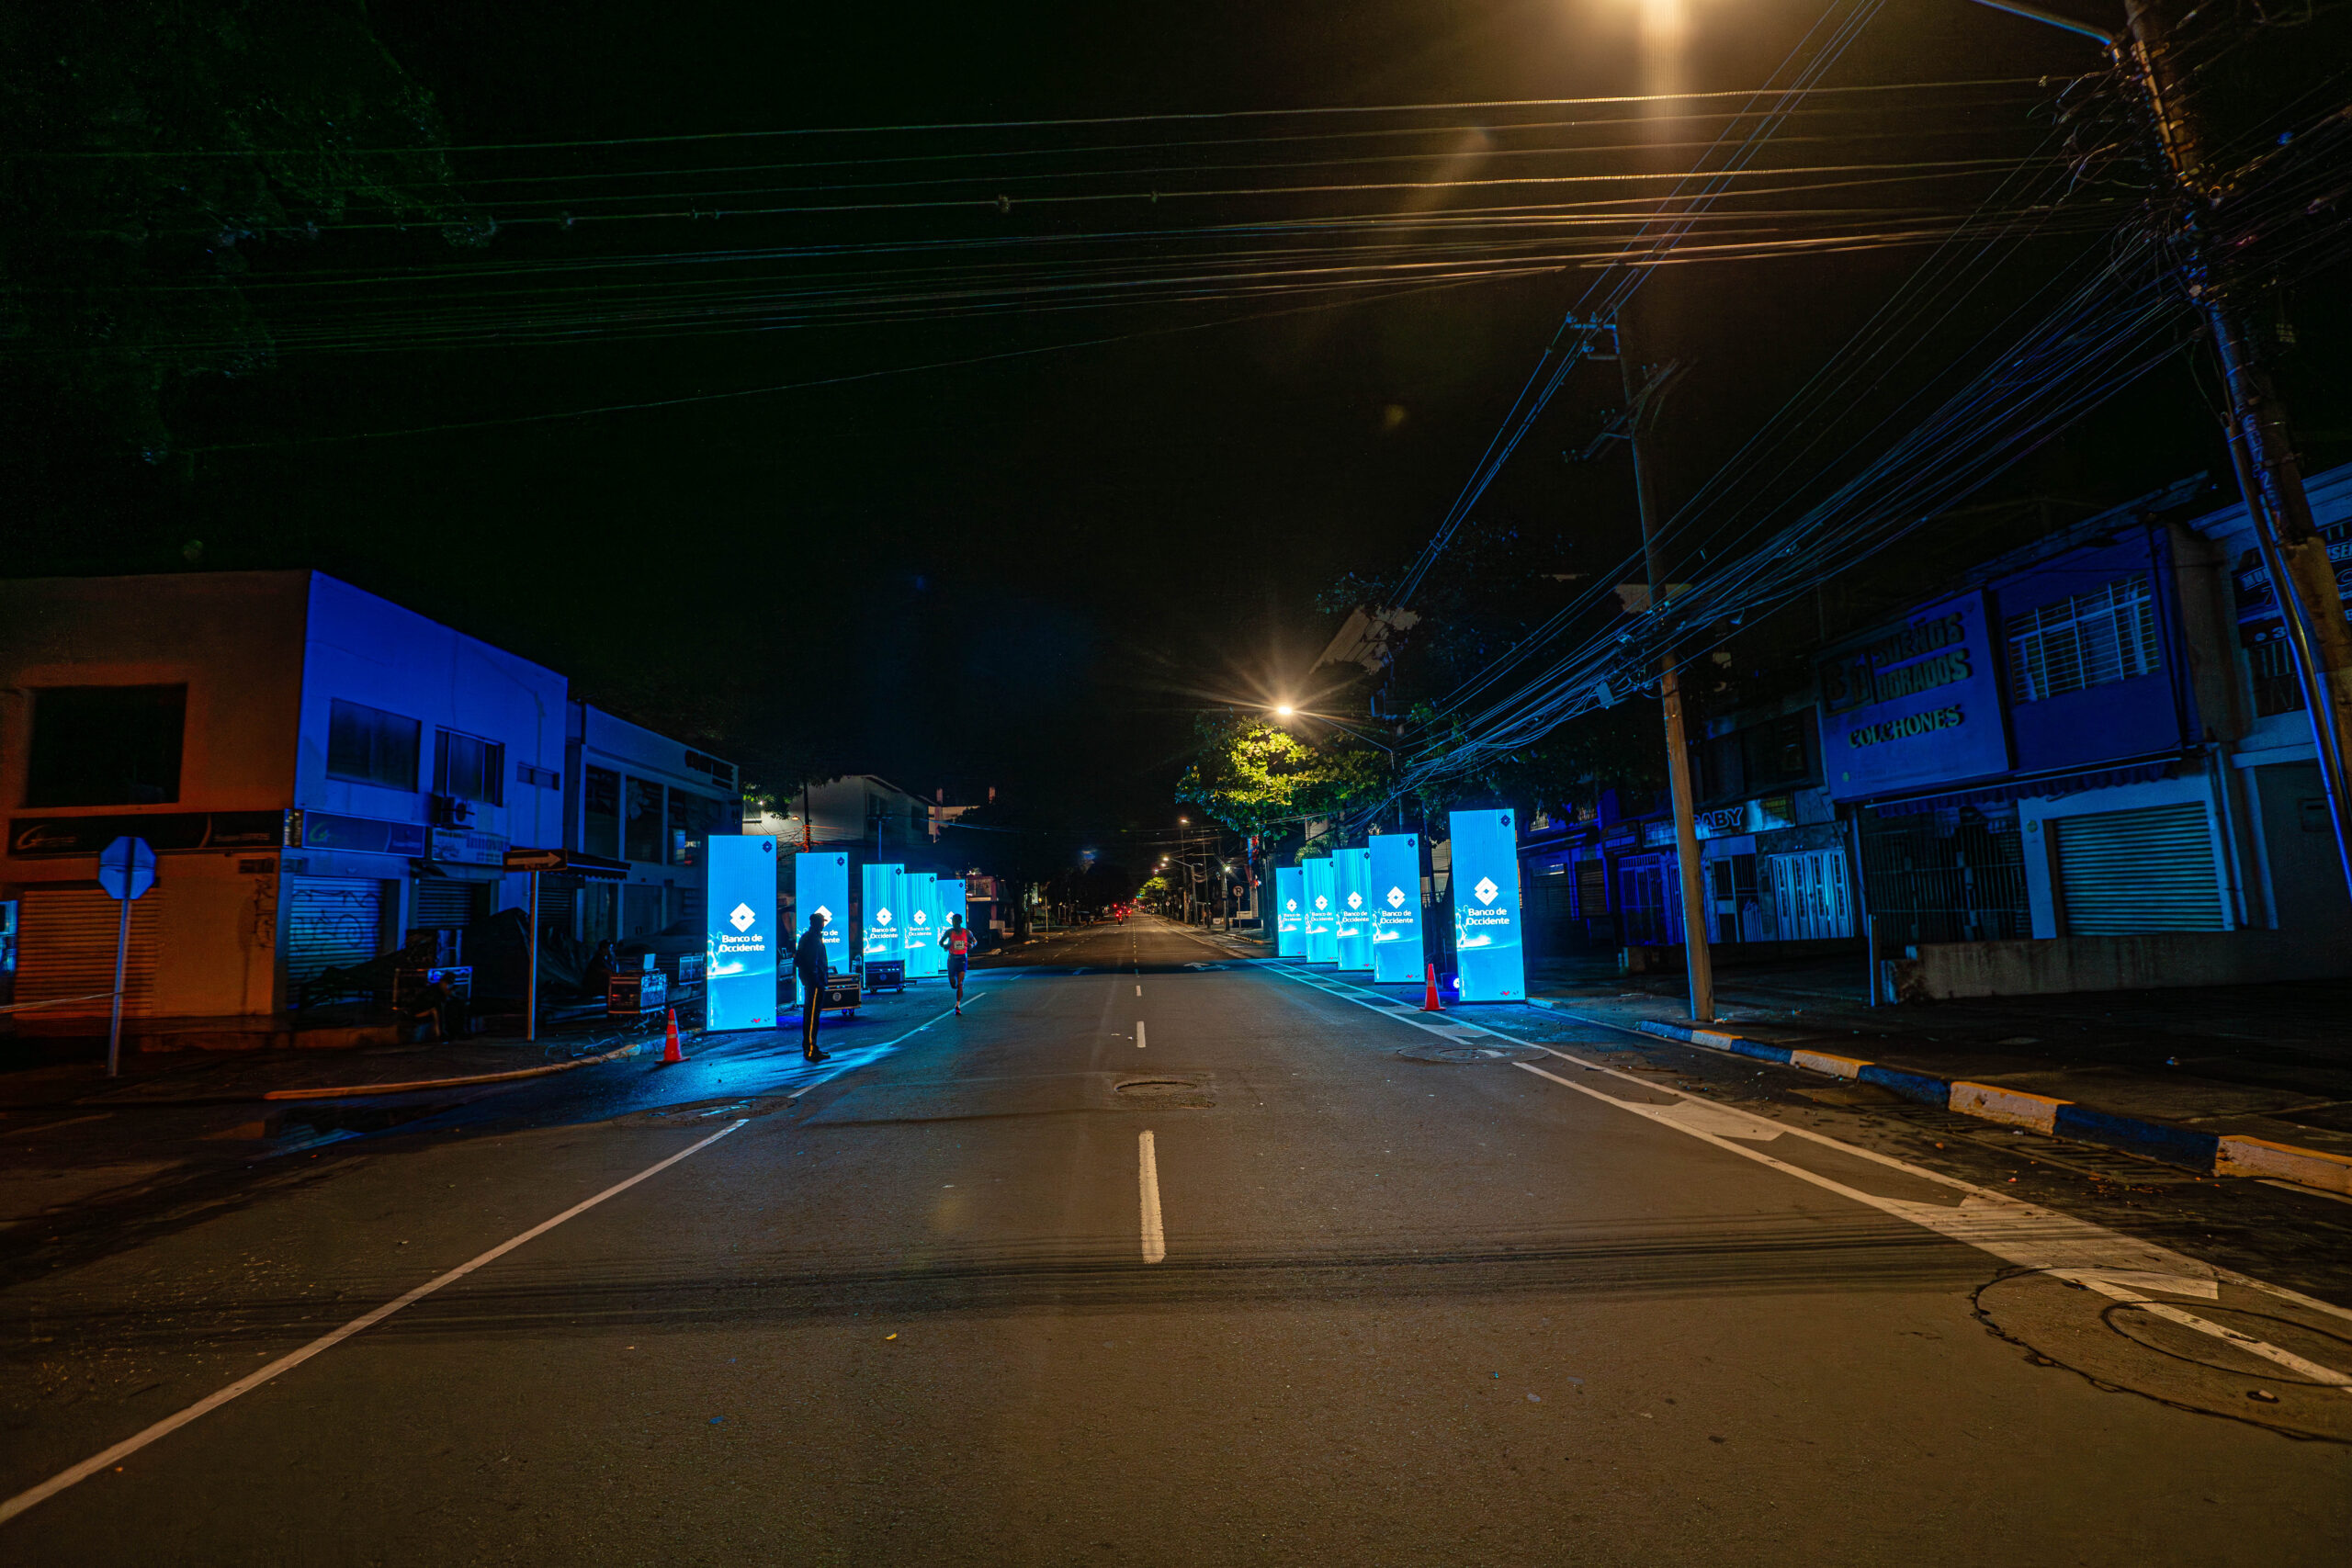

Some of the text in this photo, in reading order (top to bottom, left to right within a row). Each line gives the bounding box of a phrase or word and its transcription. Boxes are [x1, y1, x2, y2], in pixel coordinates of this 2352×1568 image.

[1849, 704, 1964, 750] COLCHONES
[1468, 907, 1508, 916] Banco de
[1466, 917, 1510, 926] Occidente
[721, 933, 763, 943] Banco de
[719, 943, 765, 953] Occidente
